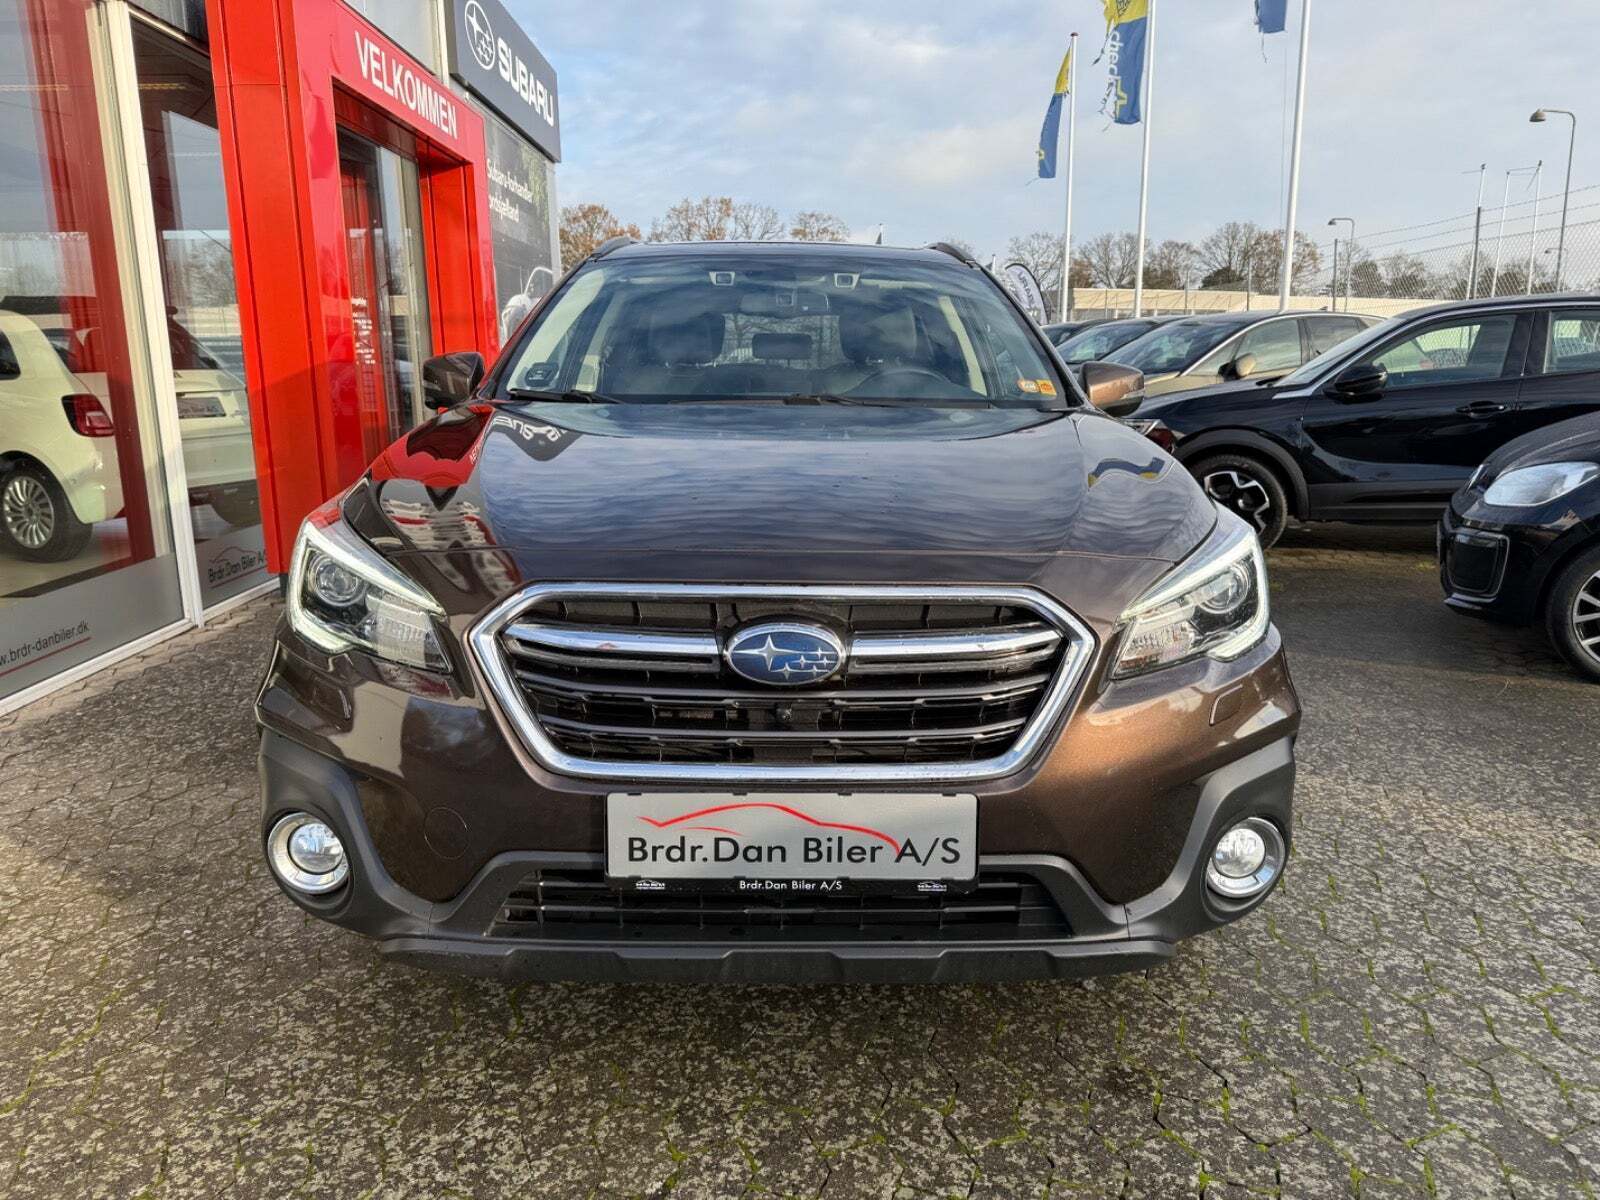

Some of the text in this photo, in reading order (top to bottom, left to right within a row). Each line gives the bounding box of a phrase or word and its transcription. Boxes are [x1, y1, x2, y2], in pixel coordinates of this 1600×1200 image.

[354, 31, 458, 140] VELKOMMEN
[496, 37, 555, 128] SUBARU
[627, 835, 961, 867] Brdr.Dan Biler A/S
[739, 880, 843, 892] Brdr.Dan Biler A/S
